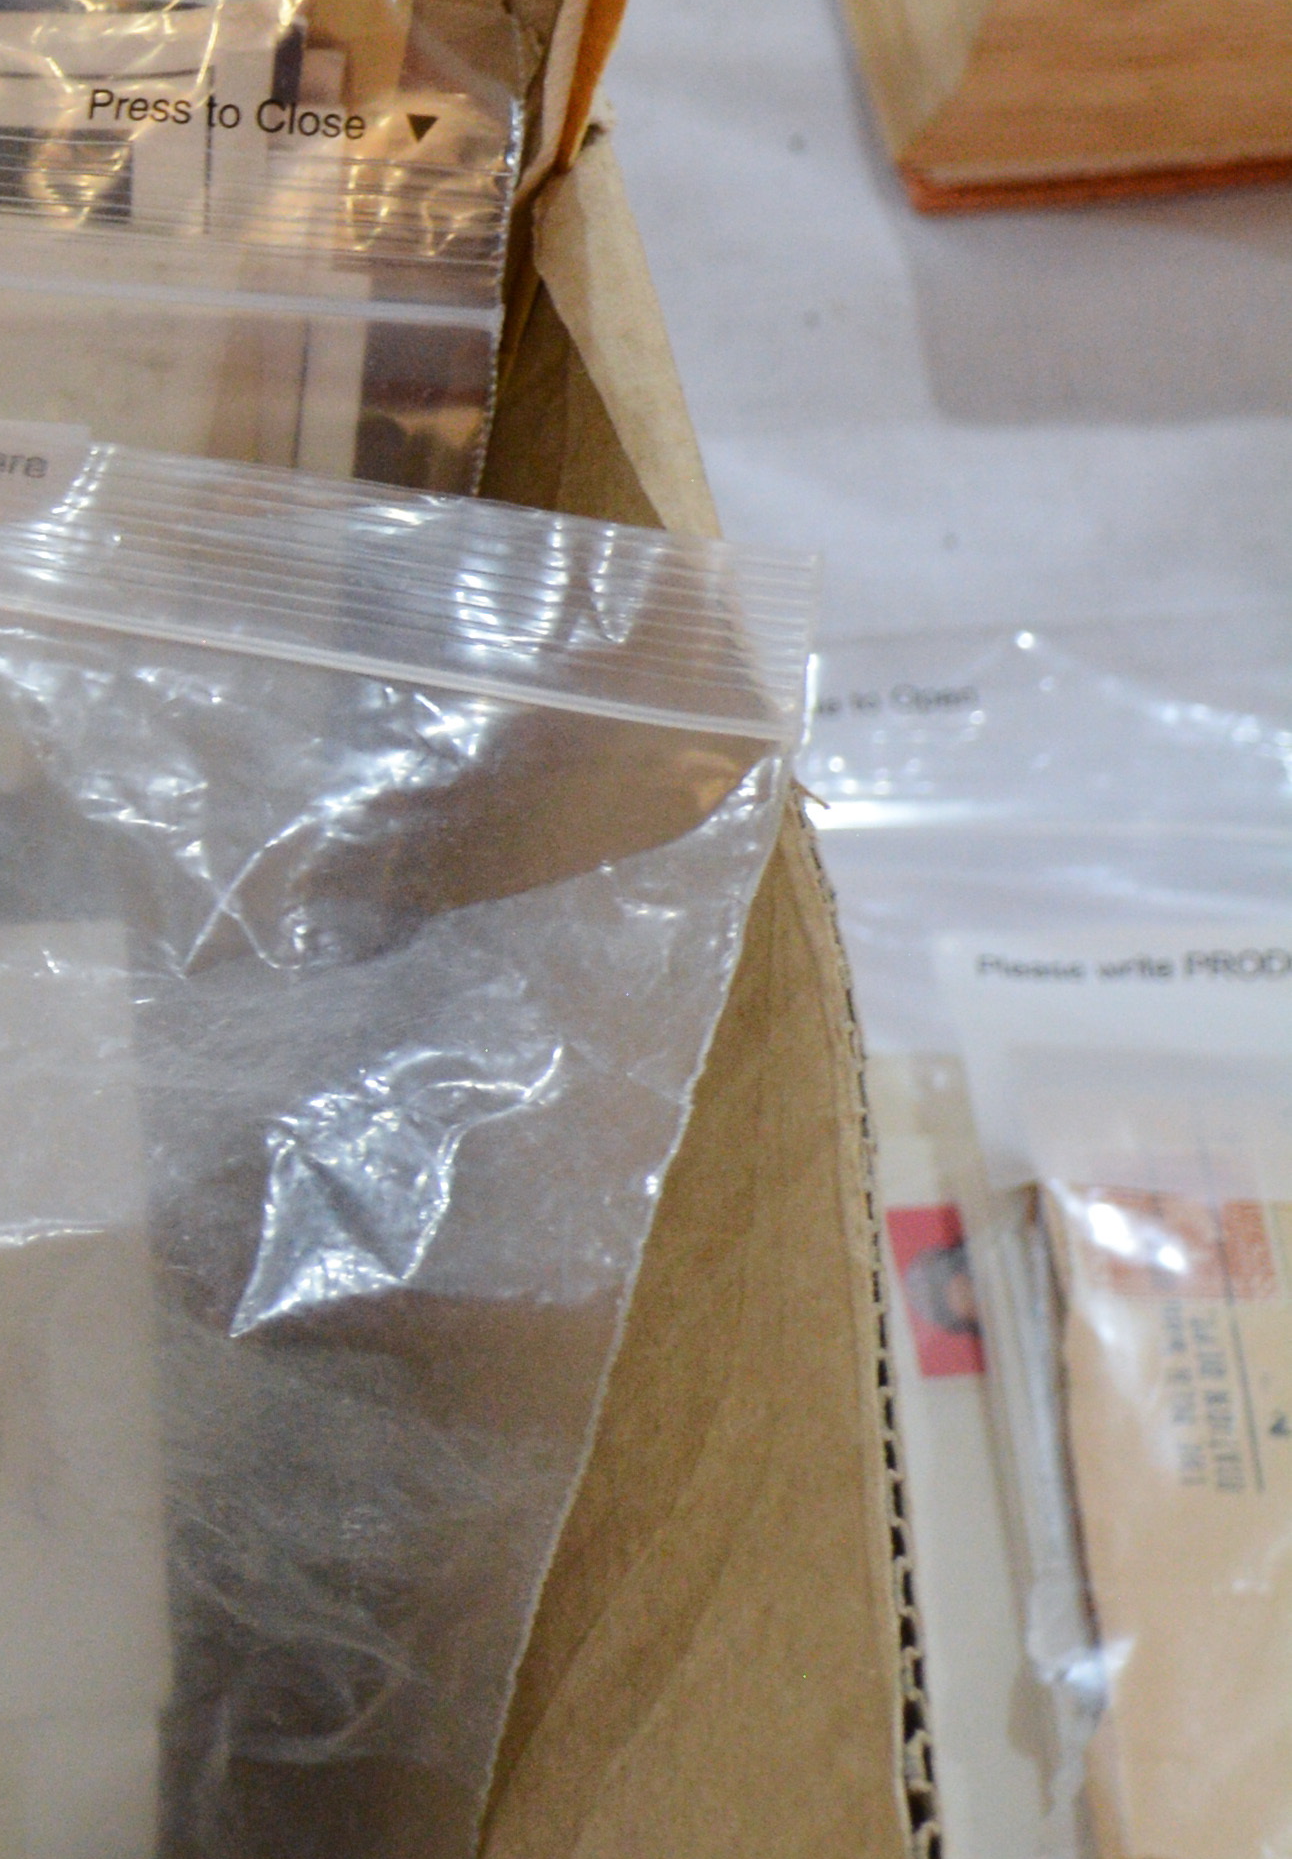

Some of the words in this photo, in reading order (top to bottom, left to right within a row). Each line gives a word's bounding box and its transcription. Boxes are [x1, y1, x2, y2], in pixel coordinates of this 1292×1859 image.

[87, 87, 193, 128] Press
[205, 96, 244, 132] to
[255, 100, 367, 142] Close
[1183, 947, 1292, 980] PROD
